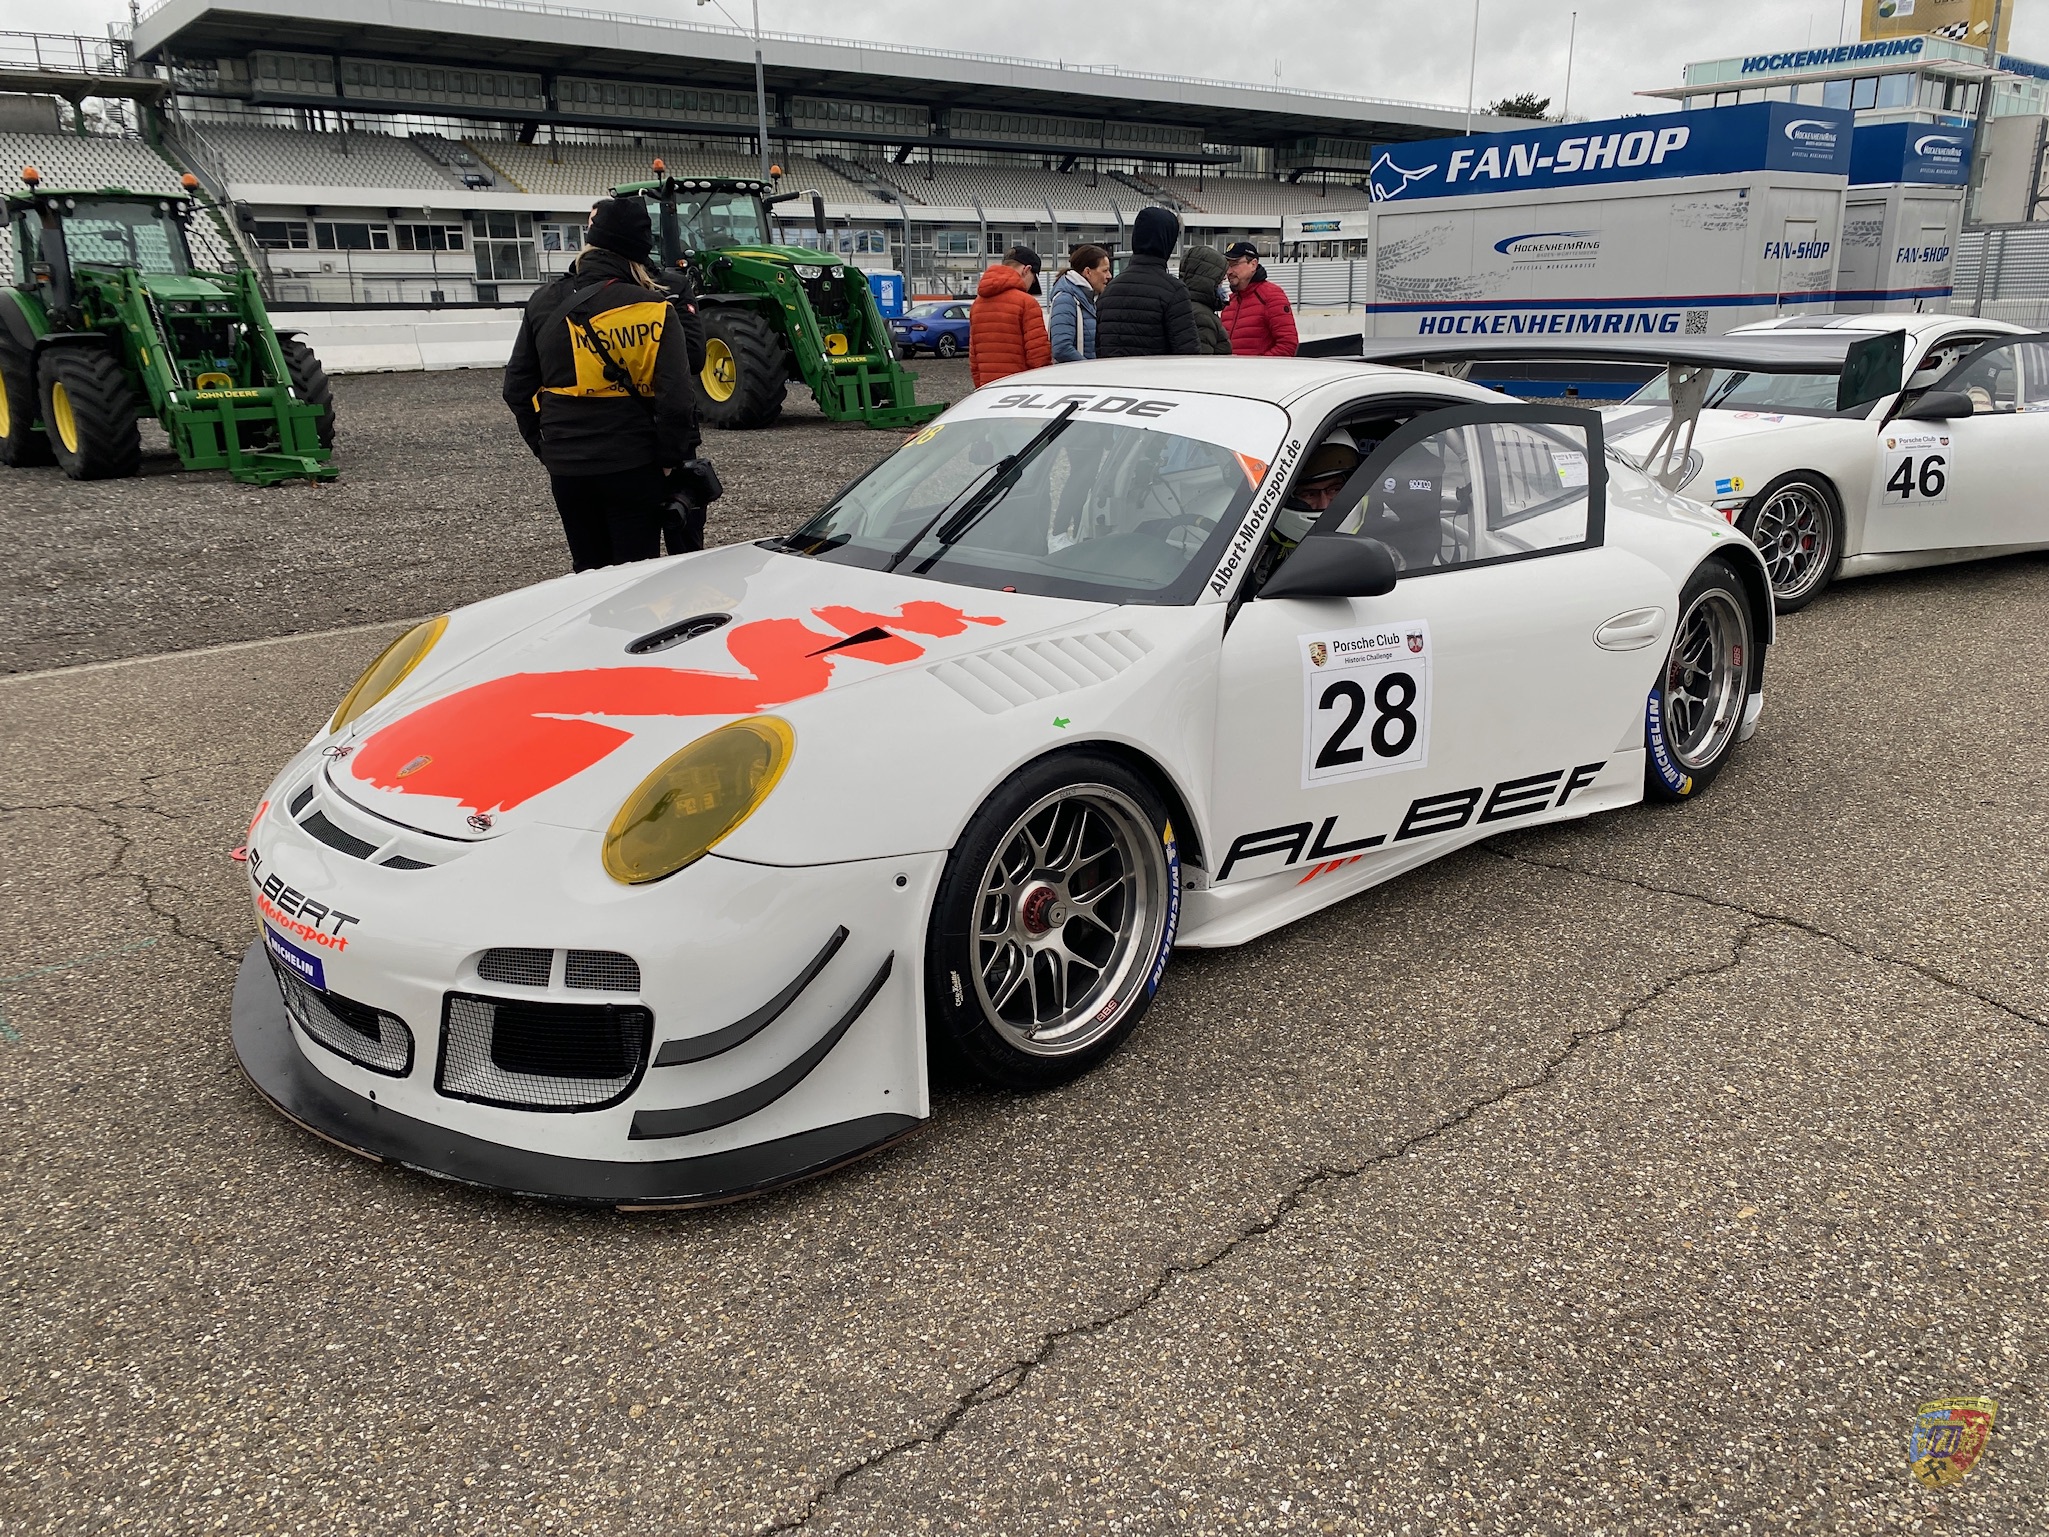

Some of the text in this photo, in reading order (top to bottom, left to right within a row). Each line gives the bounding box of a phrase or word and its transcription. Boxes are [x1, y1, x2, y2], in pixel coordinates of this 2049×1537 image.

[1741, 37, 1925, 73] HOCKENHEIMRING
[1445, 126, 1690, 183] FAN-SHOP
[1303, 223, 1338, 231] RAVENOL
[1514, 241, 1600, 253] HOCKENHEIMRING
[1763, 241, 1830, 259] FAN-SHOP
[1896, 246, 1950, 263] FAN-SHOP
[1418, 313, 1681, 335] HOCKENHEIMRING
[196, 390, 259, 399] JOHN DEERE
[1899, 436, 1922, 444] Porsche
[1886, 454, 1946, 499] 46
[1210, 438, 1301, 598] Albert-Motorsport.de
[1333, 632, 1400, 653] Porsche Club
[1344, 652, 1393, 664] Historic Challenge
[1315, 672, 1417, 769] 28
[1649, 697, 1680, 784] MICHELIN
[250, 847, 361, 936] ALBERT
[257, 893, 349, 953] Motorsport
[1152, 865, 1180, 987] MICHELIN
[270, 936, 314, 977] MICHELIN
[1096, 999, 1118, 1022] BBS
